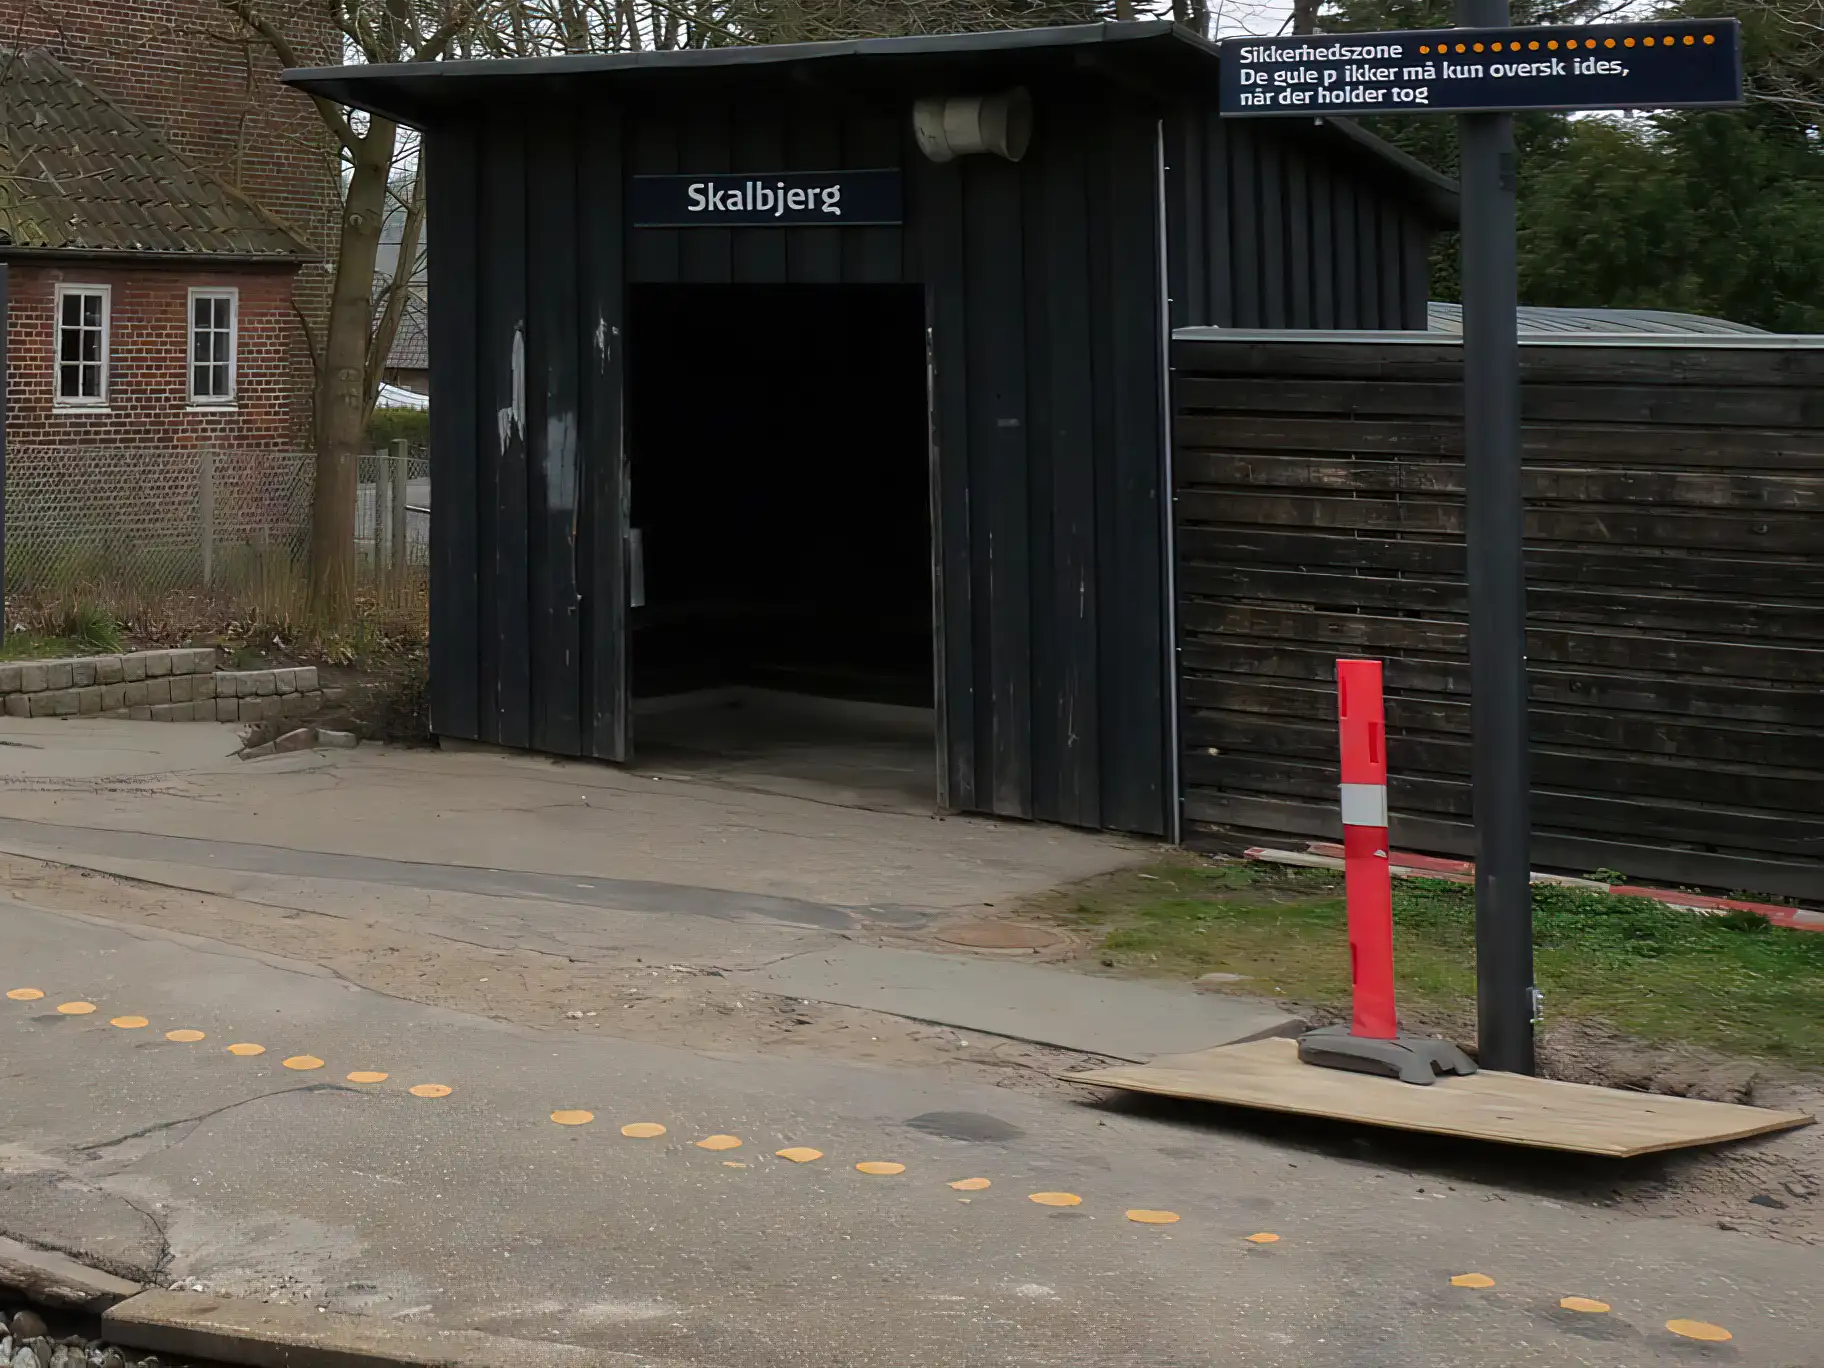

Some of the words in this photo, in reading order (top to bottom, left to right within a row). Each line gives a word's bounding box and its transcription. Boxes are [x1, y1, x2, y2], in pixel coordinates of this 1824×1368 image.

[1239, 43, 1403, 64] Sikkerhedszone
[1240, 68, 1269, 85] De
[1273, 66, 1319, 87] gule
[1402, 61, 1436, 81] må
[1442, 61, 1484, 79] kun
[1240, 87, 1275, 106] når
[1278, 87, 1314, 105] der
[1317, 85, 1387, 104] holder
[1391, 86, 1429, 104] tog
[687, 181, 842, 217] Skalbjerg
